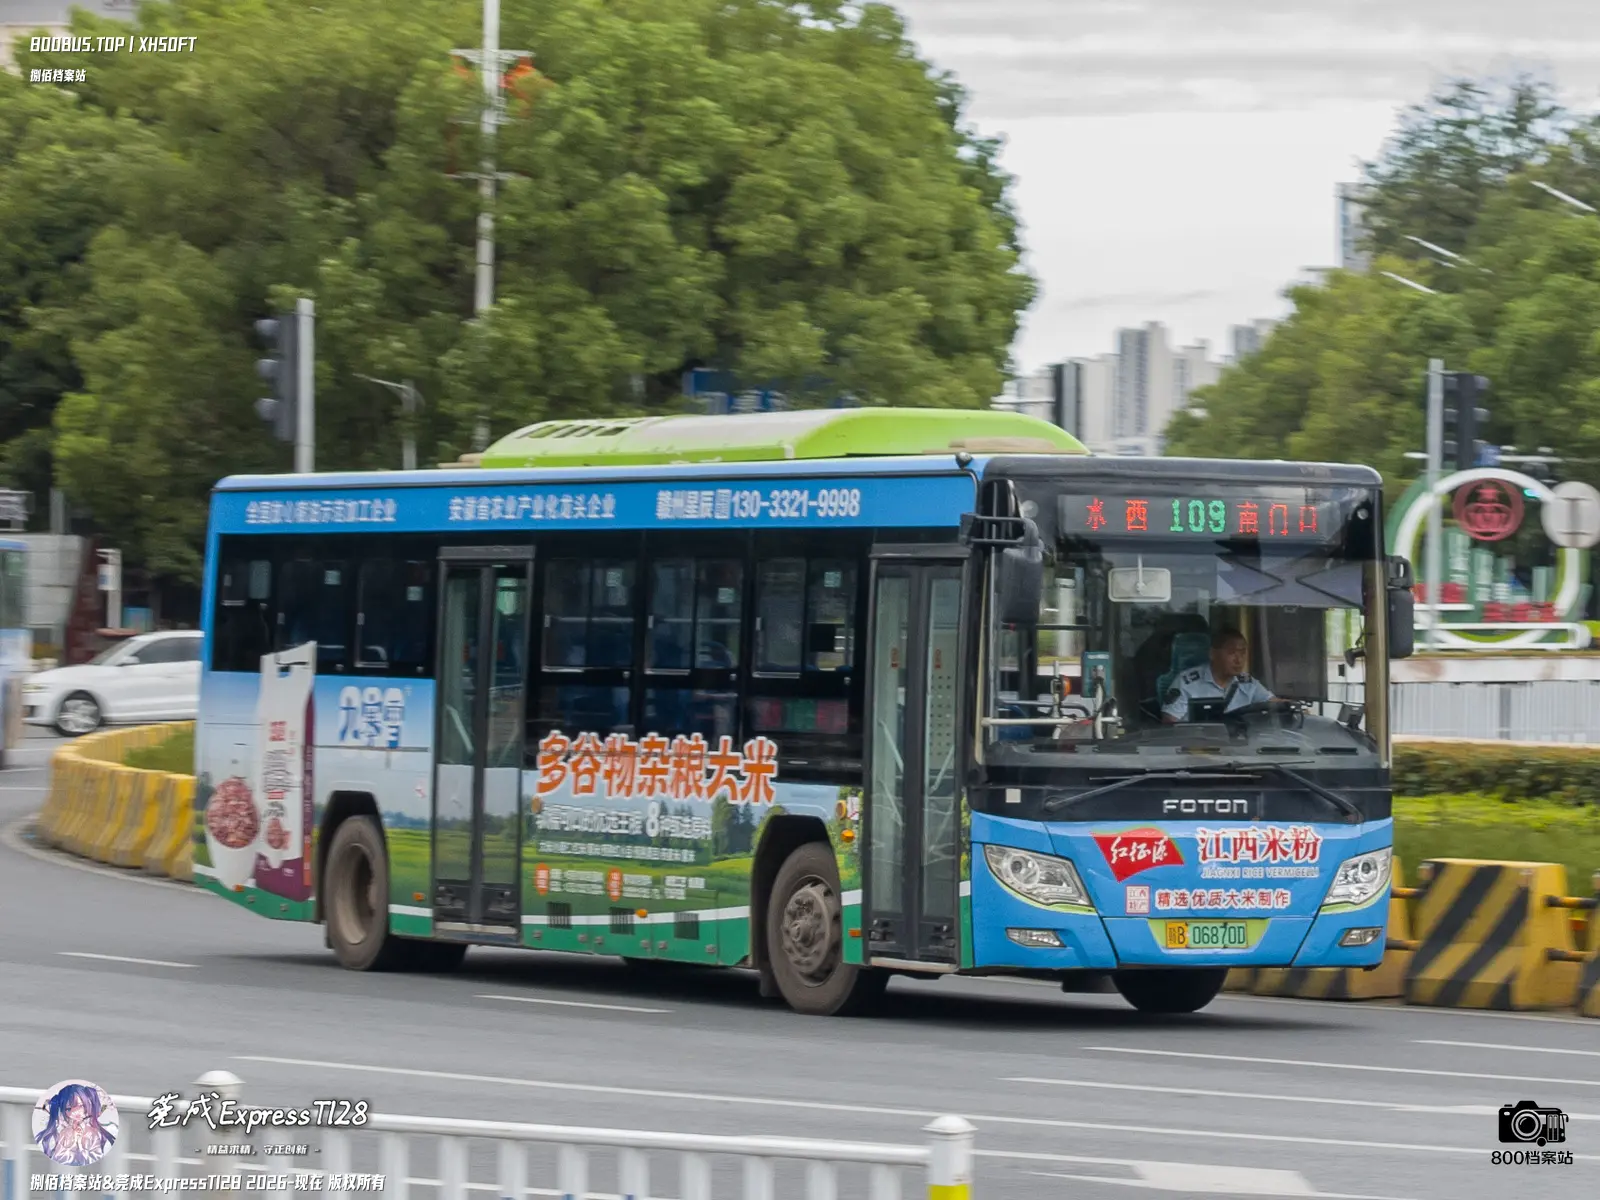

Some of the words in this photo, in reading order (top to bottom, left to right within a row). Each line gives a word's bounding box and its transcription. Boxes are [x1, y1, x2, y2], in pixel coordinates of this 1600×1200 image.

[732, 488, 860, 518] 130-3321-9998
[1170, 499, 1226, 533] 109
[536, 729, 778, 806] 多谷物杂粮大米
[1163, 799, 1248, 814] FOTON
[1197, 826, 1323, 864] 江西米粉
[1155, 889, 1291, 909] 精选优质大米制作
